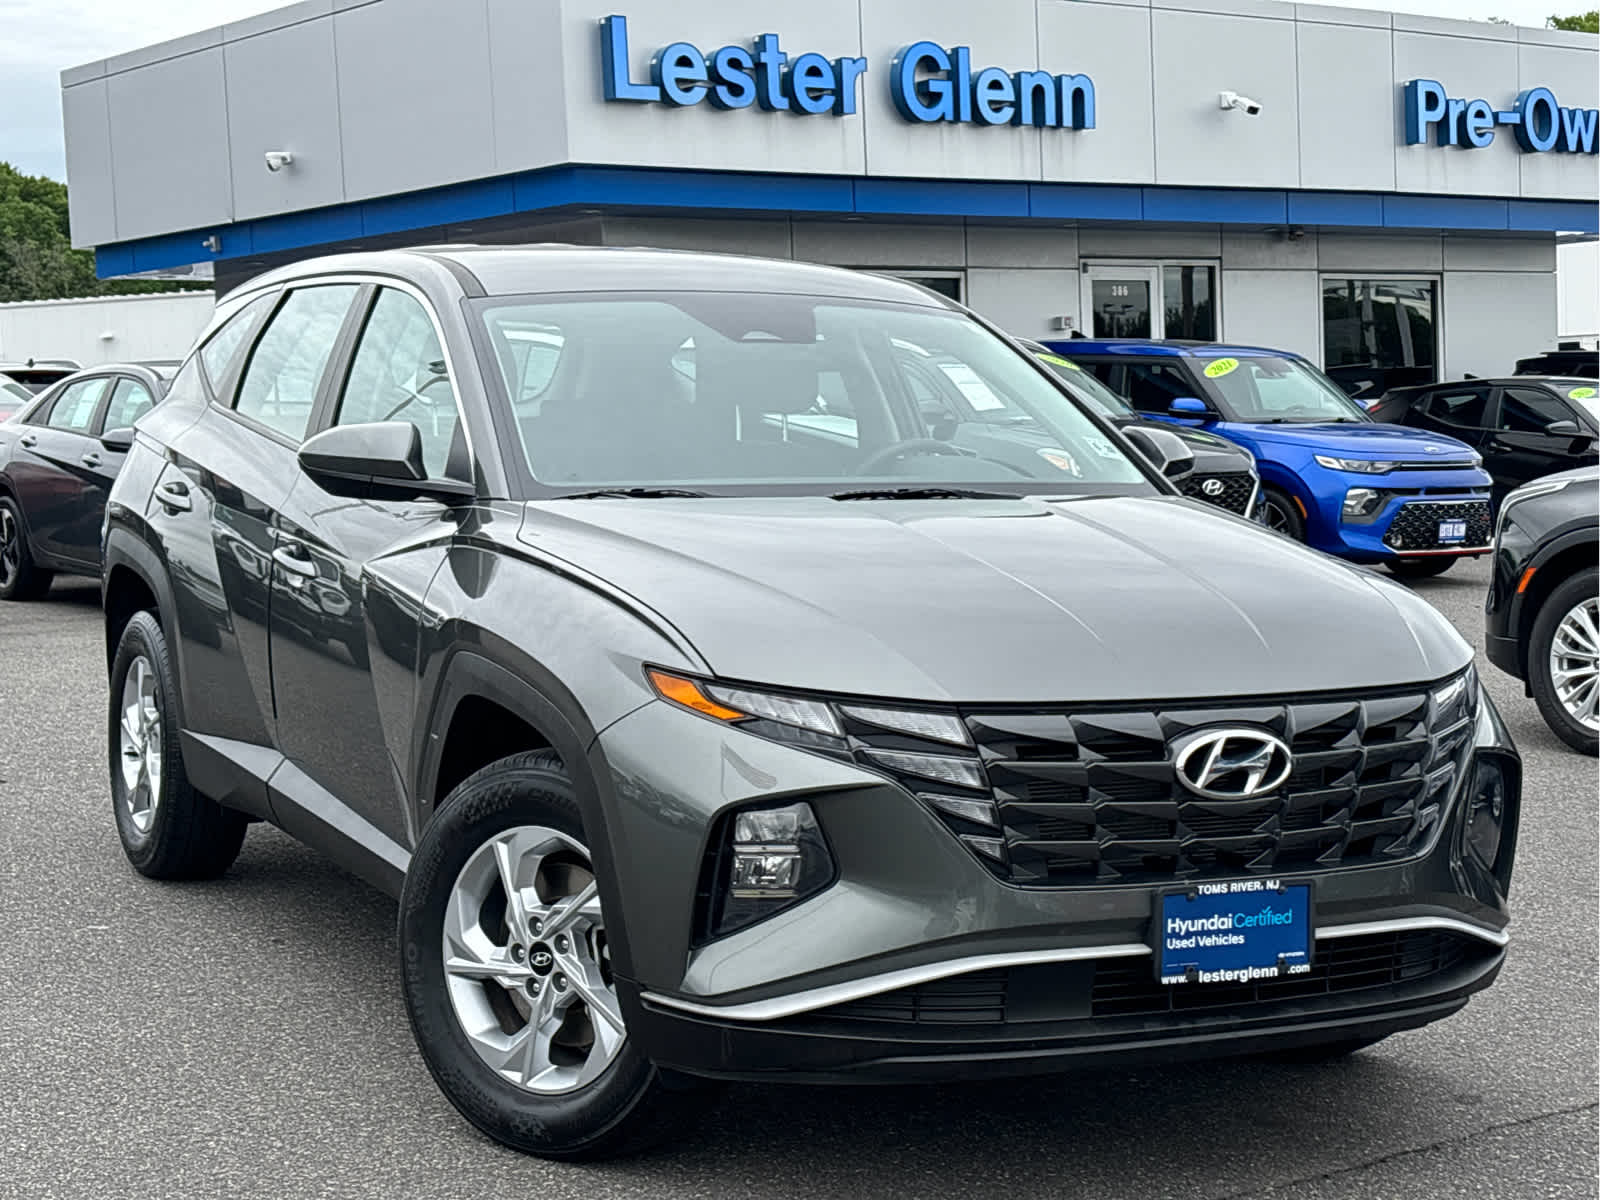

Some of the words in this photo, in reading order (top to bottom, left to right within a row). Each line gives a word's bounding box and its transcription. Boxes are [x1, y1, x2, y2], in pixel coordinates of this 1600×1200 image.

[600, 15, 867, 115] Lester
[891, 41, 1096, 130] Glenn
[1197, 883, 1228, 895] TOMS
[1266, 880, 1280, 889] NJ
[1167, 913, 1233, 936] Hyundai
[1233, 905, 1293, 928] Certified
[1167, 936, 1196, 950] Used
[1197, 933, 1245, 947] Vehicles
[1161, 976, 1188, 985] www.
[1199, 966, 1278, 984] lesterglenn
[1287, 964, 1310, 975] .com
